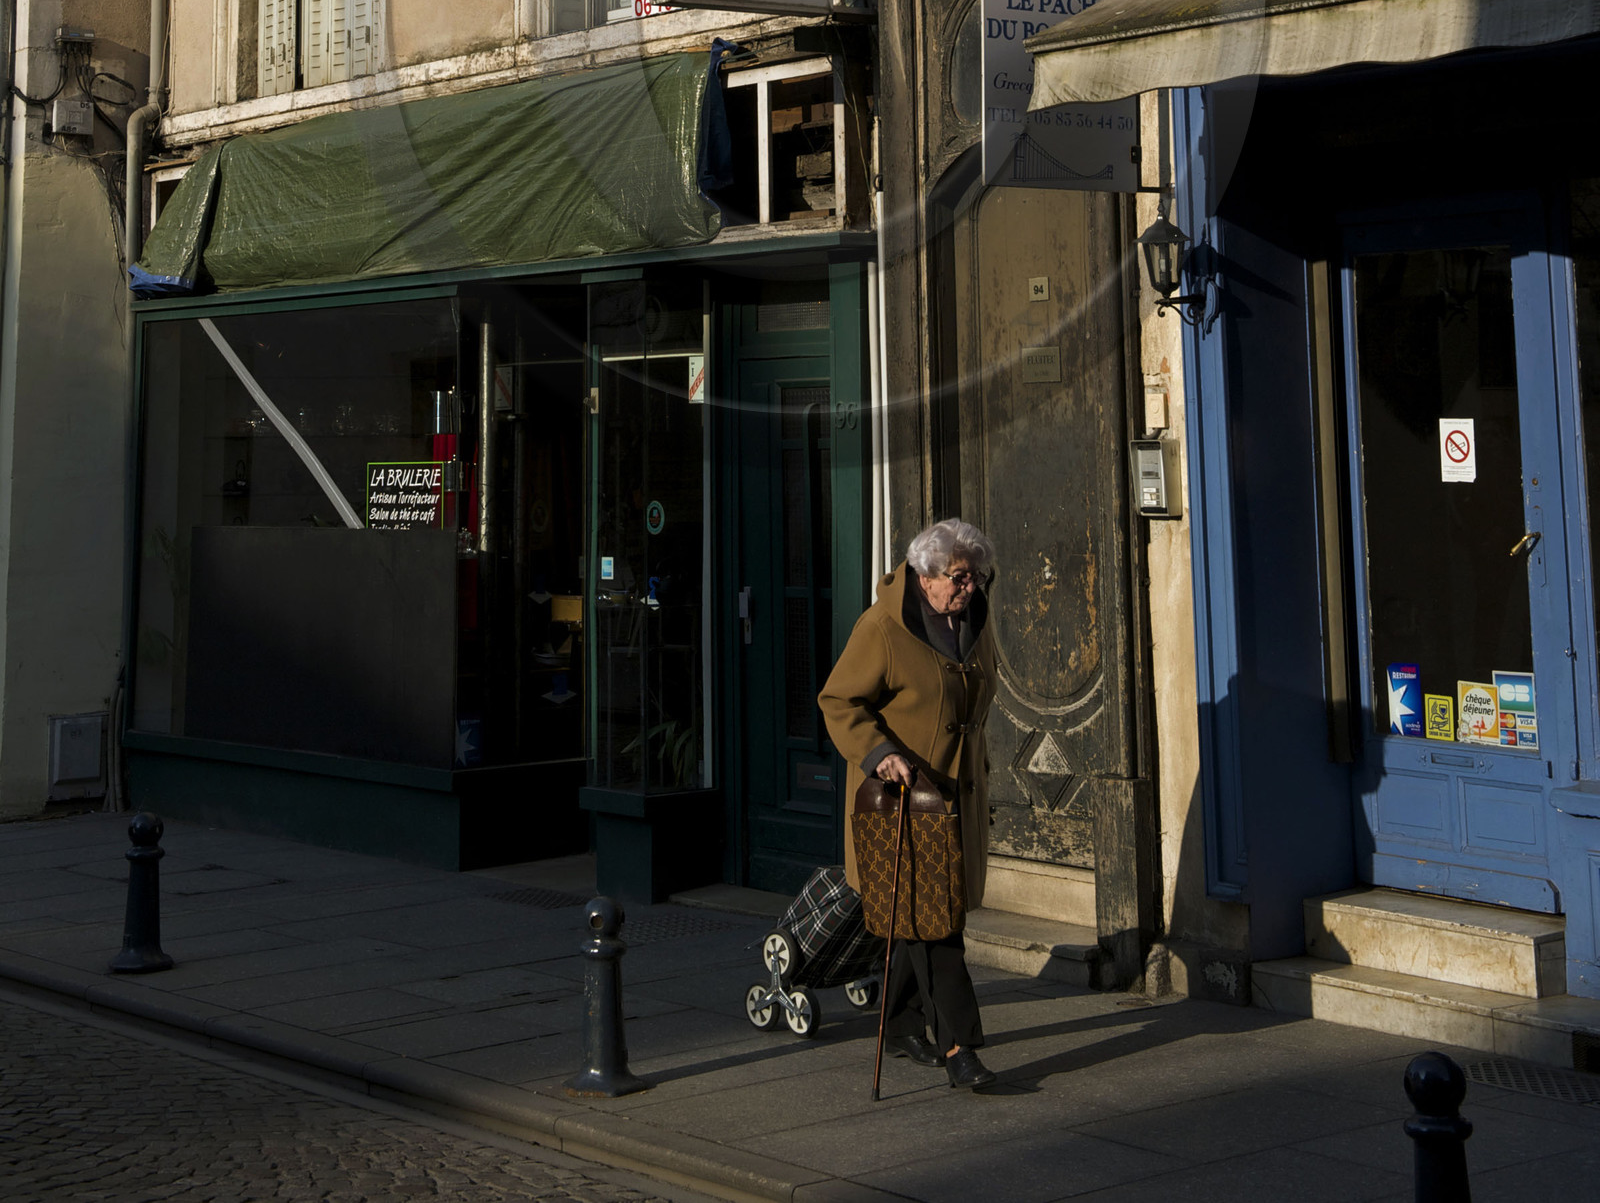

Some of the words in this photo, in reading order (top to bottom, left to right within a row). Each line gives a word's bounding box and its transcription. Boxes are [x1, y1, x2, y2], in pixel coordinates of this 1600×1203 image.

[986, 18, 1018, 41] DU
[993, 71, 1034, 94] Grecq
[1033, 285, 1044, 295] 94
[834, 401, 858, 430] 96
[370, 468, 385, 487] LA
[387, 468, 441, 489] BRULERIE
[369, 491, 397, 504] Artisan
[398, 490, 440, 508] Torréfacteur
[369, 507, 389, 520] Salon
[390, 508, 398, 520] de
[399, 506, 411, 521] thé
[411, 509, 420, 521] et
[419, 506, 436, 525] café
[1465, 693, 1491, 705] chèque
[1463, 703, 1494, 716] déjeuner
[1520, 718, 1533, 726] VISA
